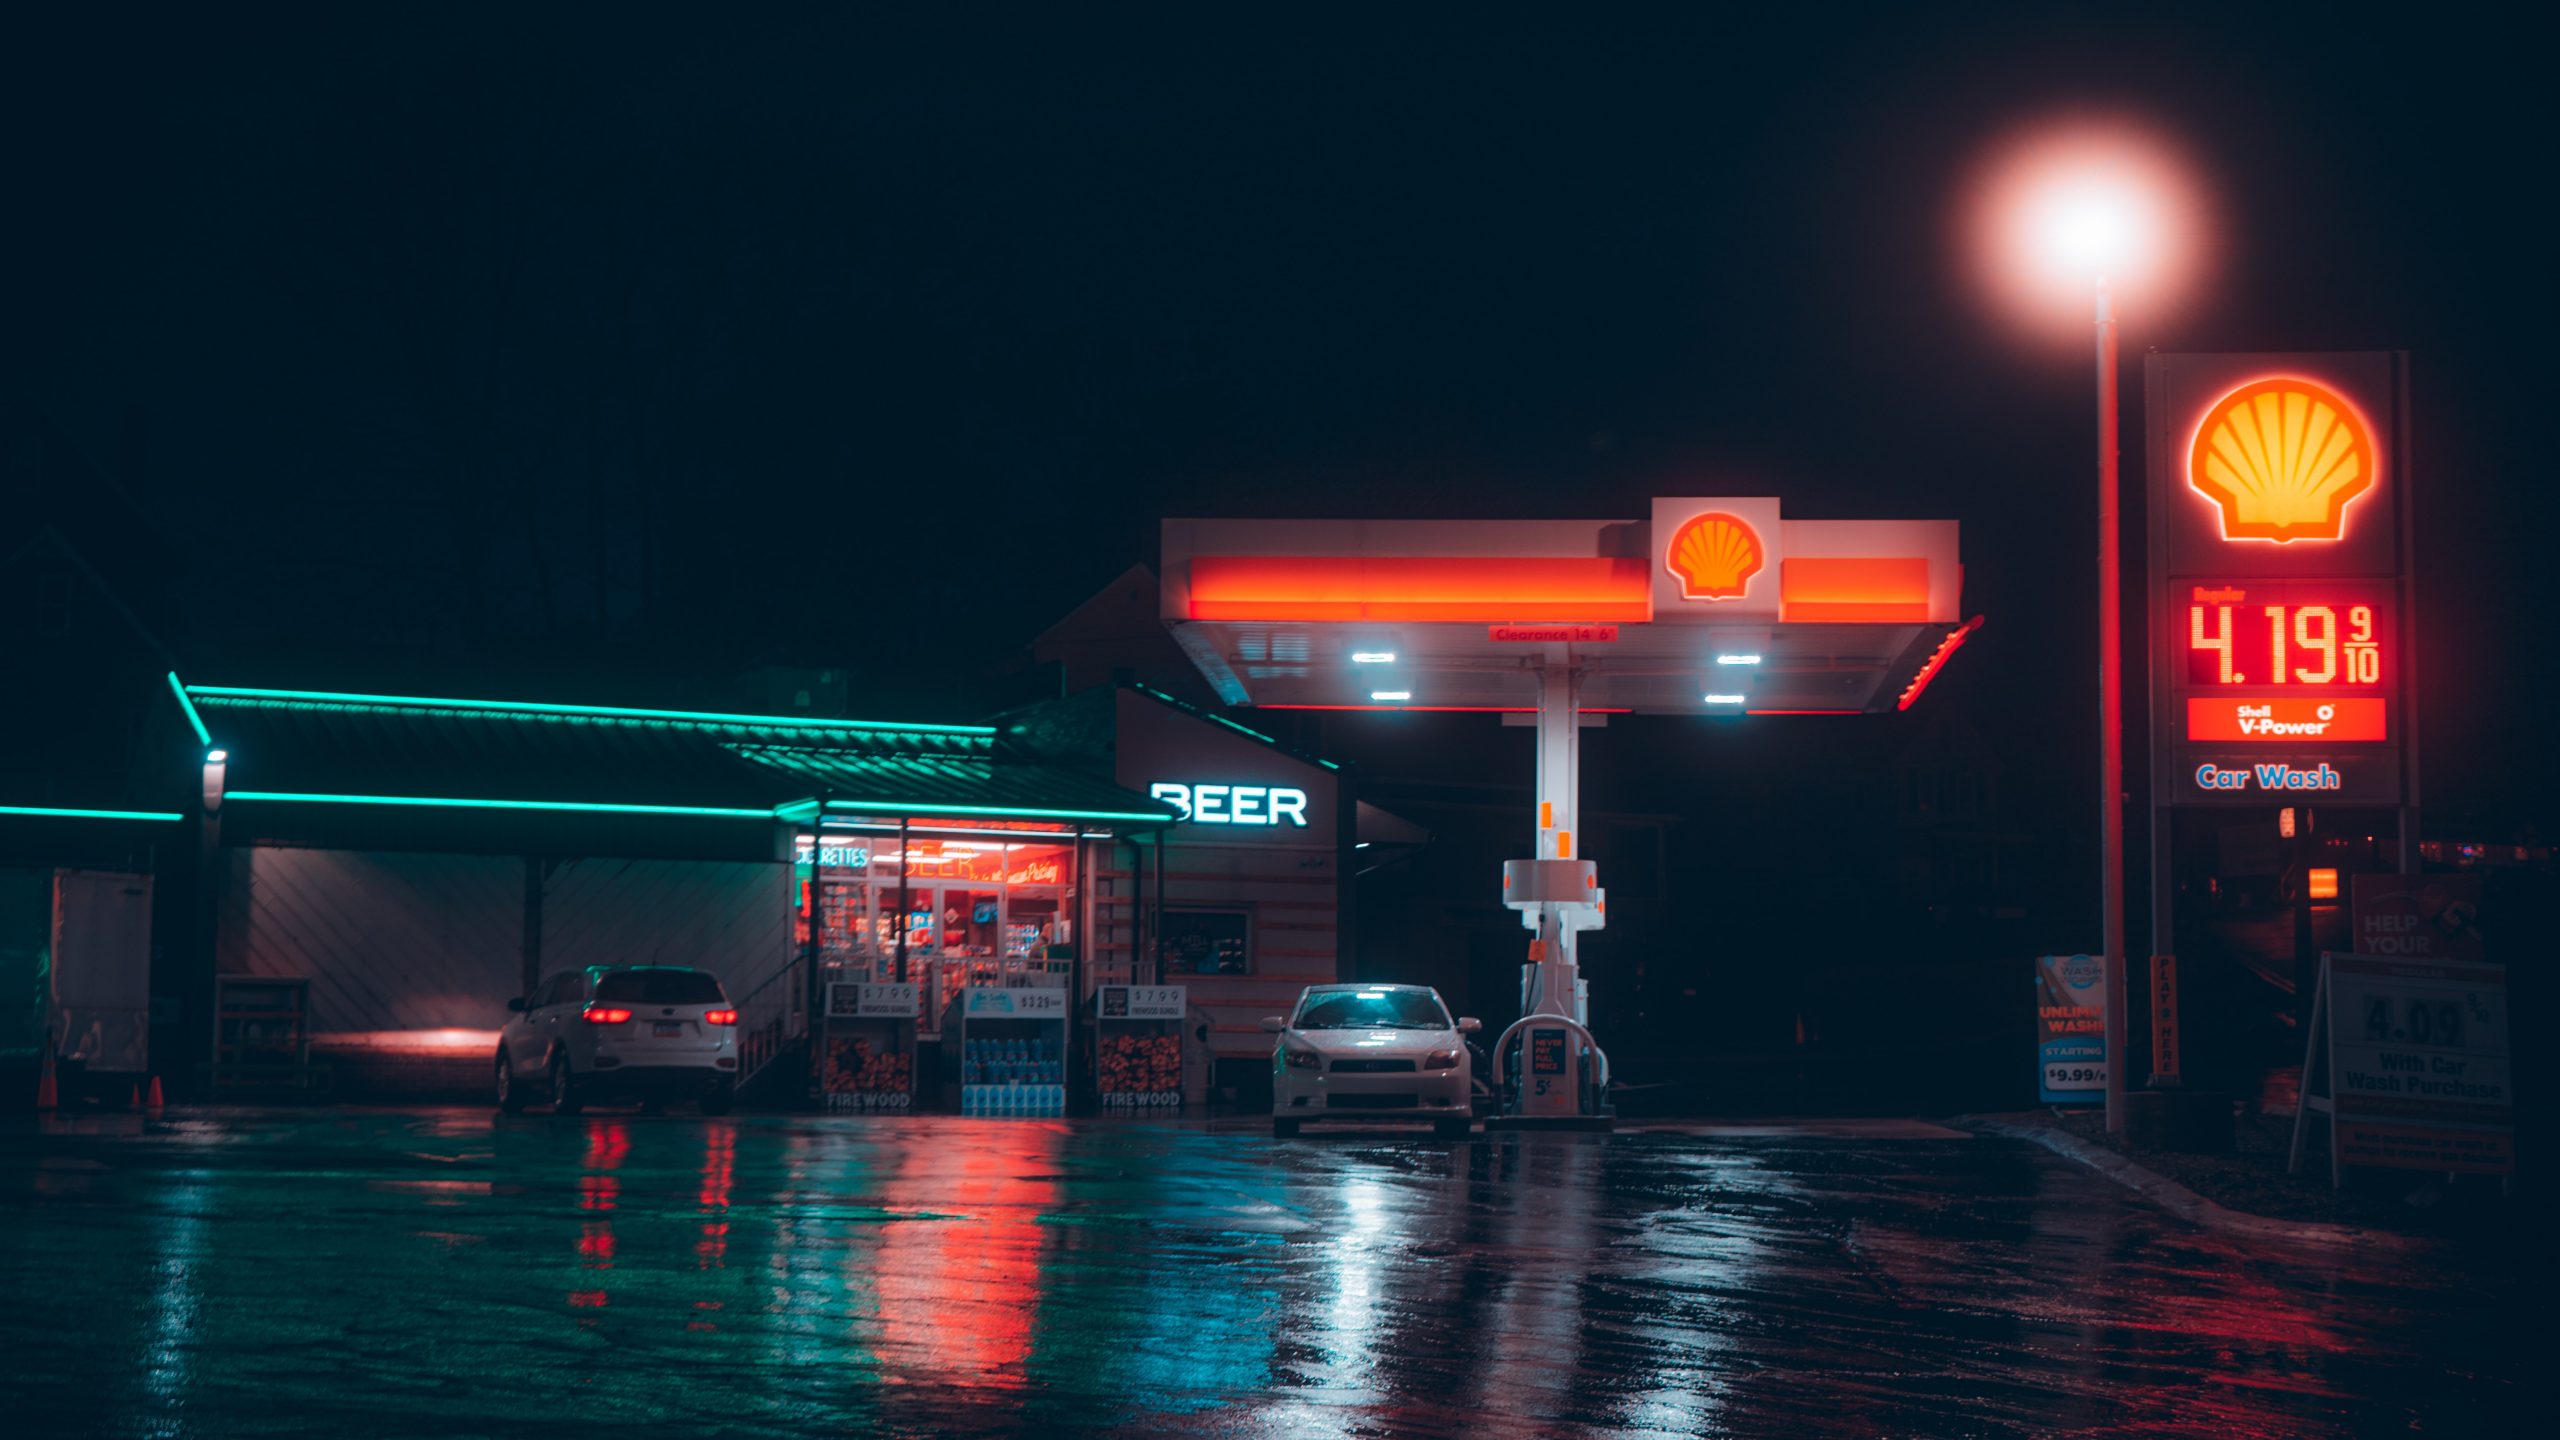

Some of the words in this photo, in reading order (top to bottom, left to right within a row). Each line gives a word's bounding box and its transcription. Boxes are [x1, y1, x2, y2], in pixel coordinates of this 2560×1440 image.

[1496, 628, 1569, 641] Clearance
[2237, 705, 2272, 718] Shell
[2238, 719, 2327, 735] V-Power
[2195, 763, 2250, 790] Car
[2254, 763, 2341, 790] Wash
[1151, 783, 1307, 827] BEER
[2364, 915, 2418, 932] HELP
[2364, 936, 2430, 954] YOUR
[2048, 1021, 2105, 1033] WASHE
[2367, 1002, 2461, 1046] 4.09
[2045, 1047, 2103, 1056] STARTING
[2379, 1053, 2425, 1073] With
[2431, 1056, 2467, 1076] Car
[2346, 1071, 2401, 1092] Wash
[2407, 1077, 2501, 1098] Purchase
[826, 1093, 911, 1108] FIREWOOD
[1102, 1092, 1181, 1107] FIREWOOD
